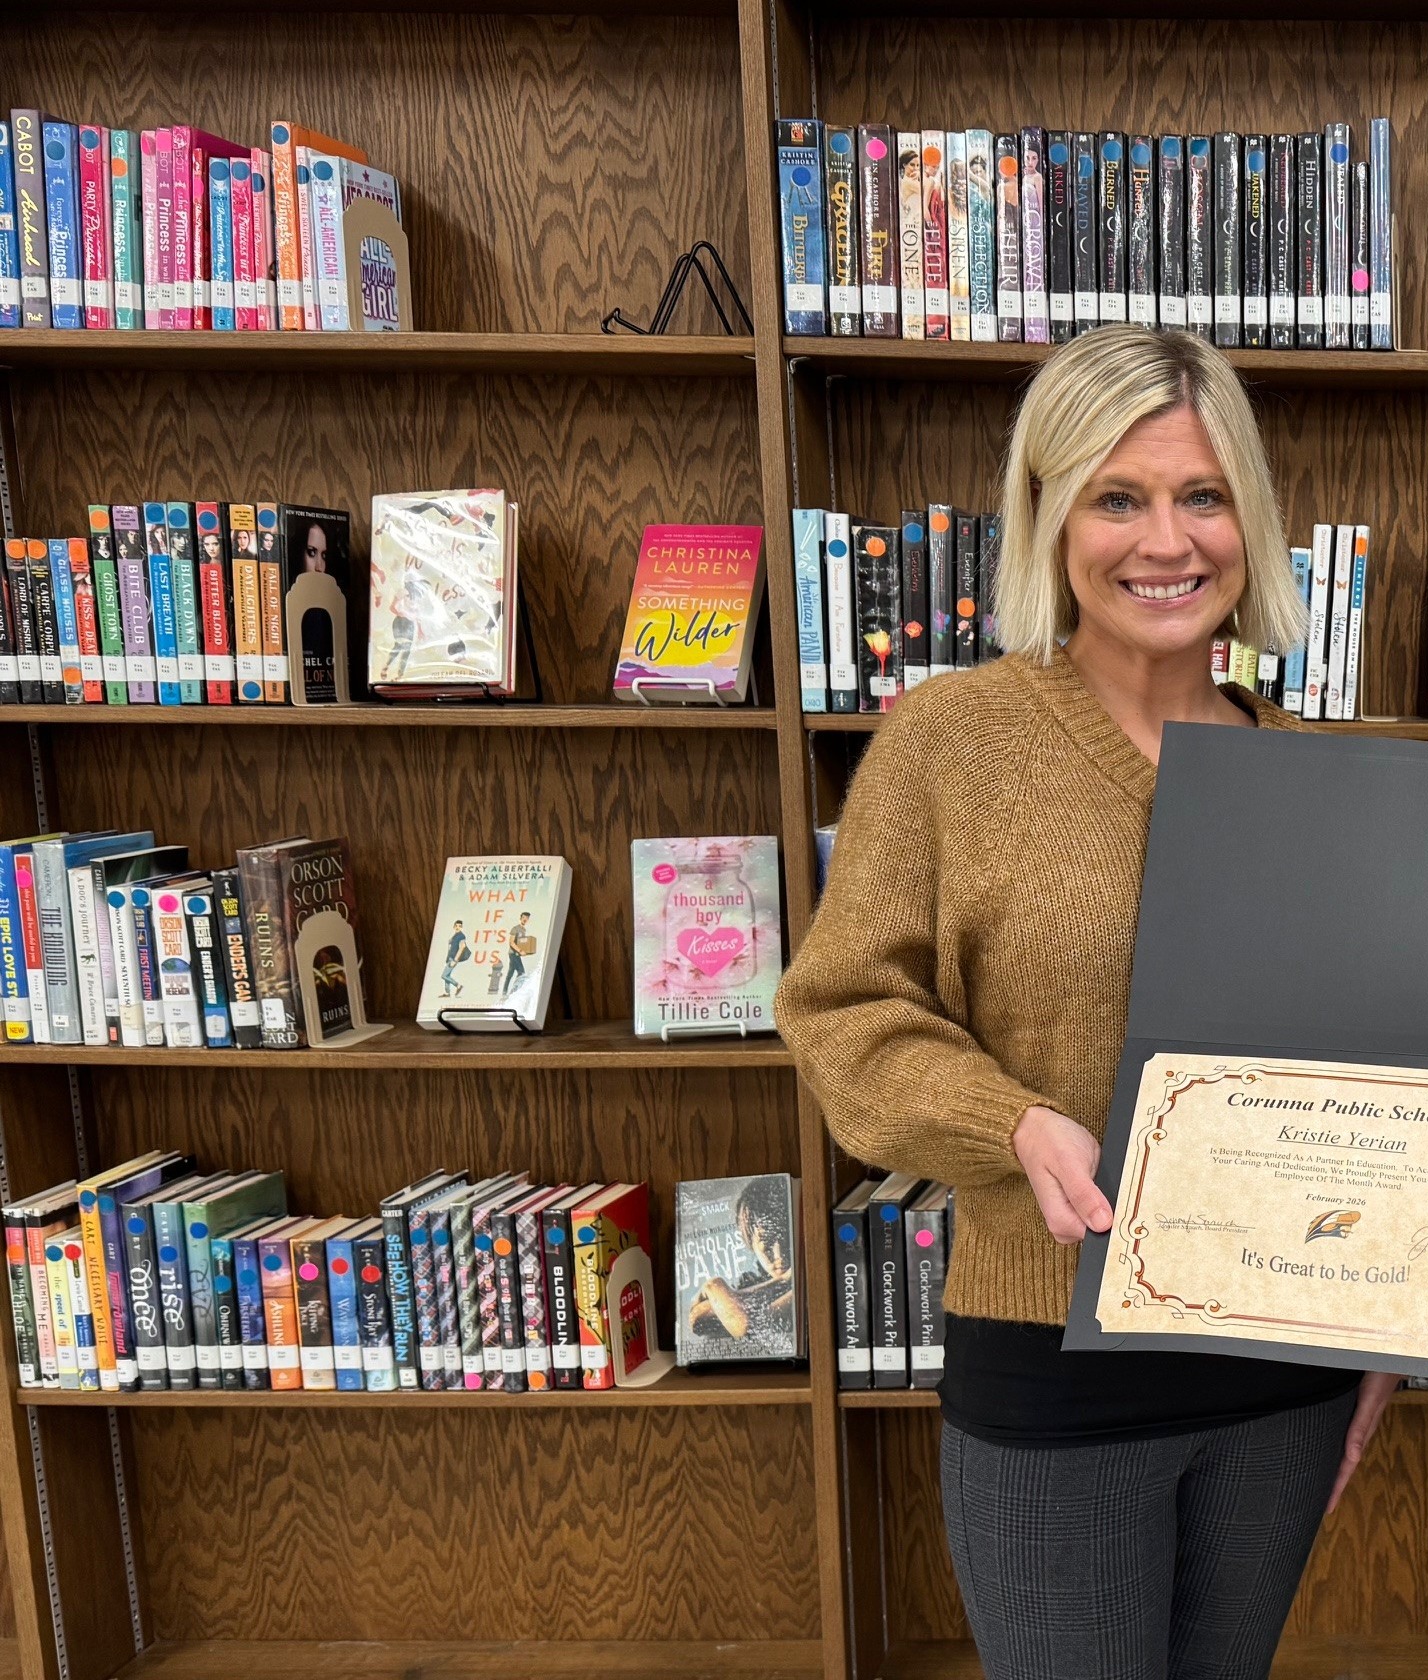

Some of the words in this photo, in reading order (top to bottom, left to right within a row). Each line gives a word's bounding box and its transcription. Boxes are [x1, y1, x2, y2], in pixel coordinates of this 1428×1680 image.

[15, 116, 34, 175] CABOT
[85, 181, 96, 214] PARTY
[20, 188, 41, 267] Airhead
[318, 206, 339, 276] ALL-AMERICAN
[901, 229, 919, 275] ONE
[924, 227, 943, 283] ELITE
[971, 224, 989, 316] SELECTION
[362, 284, 398, 322] GIRL
[647, 546, 751, 560] CHRISTINA
[654, 561, 739, 575] LAUREN
[128, 564, 142, 597] BITE
[180, 564, 193, 606] BLACK
[209, 570, 220, 606] BITTER
[244, 565, 257, 644] DAYLIGHTERS
[638, 597, 744, 610] SOMETHING
[131, 605, 145, 644] CLUB
[183, 611, 195, 644] DAWN
[212, 611, 223, 645] BLOOD
[635, 610, 740, 661] Wilder
[1313, 609, 1325, 644] Stolen
[1332, 610, 1346, 647] Stolen
[291, 854, 344, 884] ORSON
[705, 879, 713, 890] a
[293, 877, 345, 908] SCOTT
[469, 889, 528, 903] WHAT
[674, 891, 744, 907] thousand
[42, 907, 60, 928] THE
[485, 910, 504, 923] IF
[696, 909, 722, 924] boy
[1, 917, 14, 949] EPIC
[255, 912, 274, 968] RUINS
[474, 930, 507, 943] IT'S
[687, 935, 738, 956] Kisses
[3, 951, 16, 980] LOVE
[43, 932, 68, 986] KNOWING
[473, 951, 500, 965] US
[322, 1004, 349, 1023] RUINS
[658, 1003, 709, 1020] Tillie
[720, 1001, 762, 1019] Cole
[9, 1026, 25, 1035] NEW
[1227, 1092, 1313, 1111] Corunna
[1321, 1099, 1385, 1118] Public
[1277, 1125, 1341, 1144] Kristie
[1347, 1132, 1407, 1151] Yerian
[1212, 1157, 1231, 1165] Your
[1234, 1158, 1261, 1168] Caring
[1282, 1162, 1327, 1173] Dedication,
[1346, 1168, 1377, 1179] Proudly
[1379, 1171, 1407, 1181] Present
[1410, 1174, 1427, 1183] You
[1219, 1148, 1243, 1157] Being
[1245, 1151, 1291, 1160] Recognized
[1294, 1154, 1304, 1162] As
[1316, 1156, 1345, 1166] Partner
[1275, 1171, 1314, 1183] Employee
[1316, 1174, 1328, 1182] Of
[1329, 1175, 1345, 1185] The
[1347, 1178, 1372, 1188] Month
[1306, 1193, 1344, 1205] February
[1346, 1197, 1366, 1206] 2026
[386, 1235, 402, 1260] SEE
[391, 1261, 410, 1294] HOW
[1241, 1247, 1264, 1268] It's
[1269, 1256, 1315, 1278] Great
[1320, 1265, 1336, 1279] to
[1340, 1265, 1360, 1282] be
[1365, 1267, 1410, 1283] Gold!
[88, 1257, 103, 1311] NECESSARY
[97, 1317, 108, 1345] NOISE
[130, 1259, 158, 1337] once
[159, 1267, 184, 1330] rise
[844, 1262, 859, 1331] Clockwork
[882, 1260, 896, 1327] Clockwork
[919, 1259, 934, 1322] Clockwork
[395, 1300, 413, 1332] THEY
[395, 1332, 407, 1362] RUN
